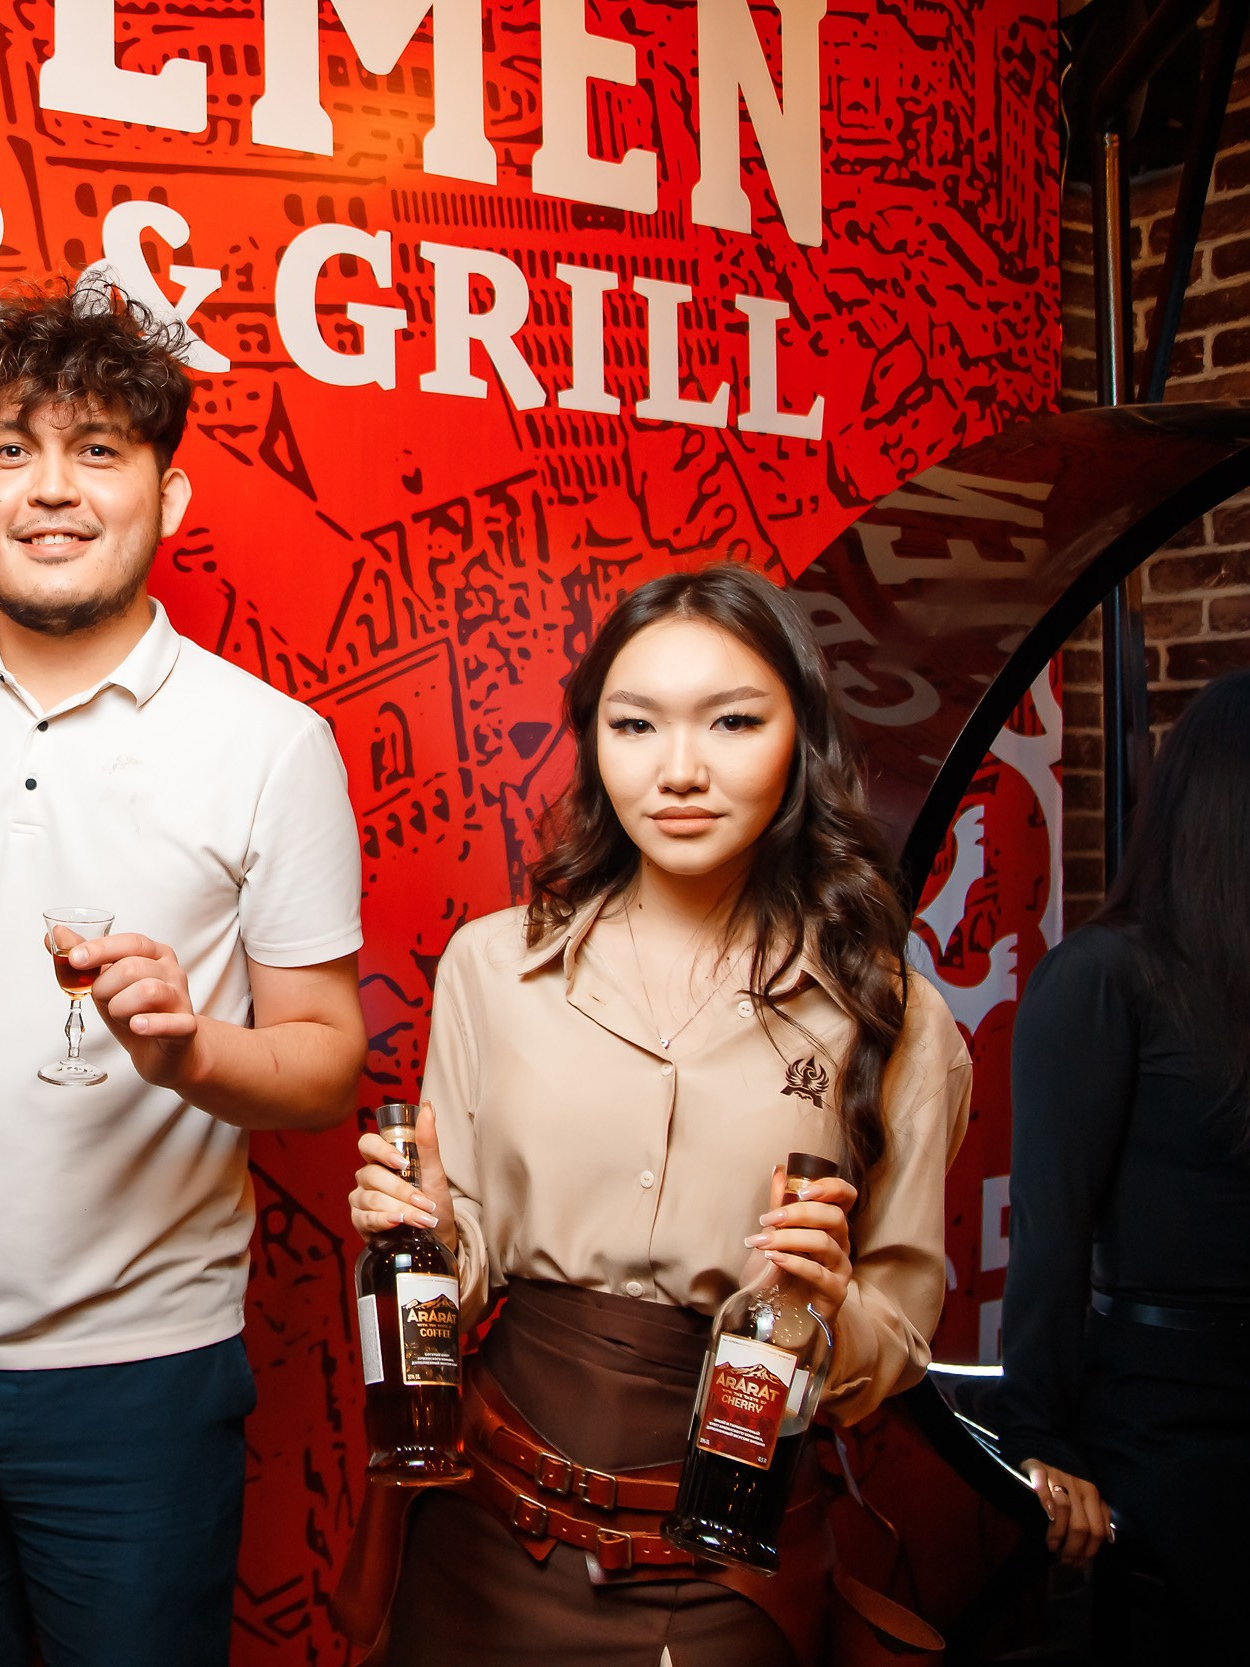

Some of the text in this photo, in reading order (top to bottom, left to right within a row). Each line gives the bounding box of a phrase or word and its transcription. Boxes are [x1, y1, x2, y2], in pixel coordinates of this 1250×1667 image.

[72, 200, 231, 373] &
[275, 223, 826, 441] GRILL
[407, 1309, 457, 1325] ARARAT
[420, 1328, 451, 1339] COFFEE
[716, 1372, 780, 1402] ARARAT
[721, 1394, 763, 1414] CHERRY
